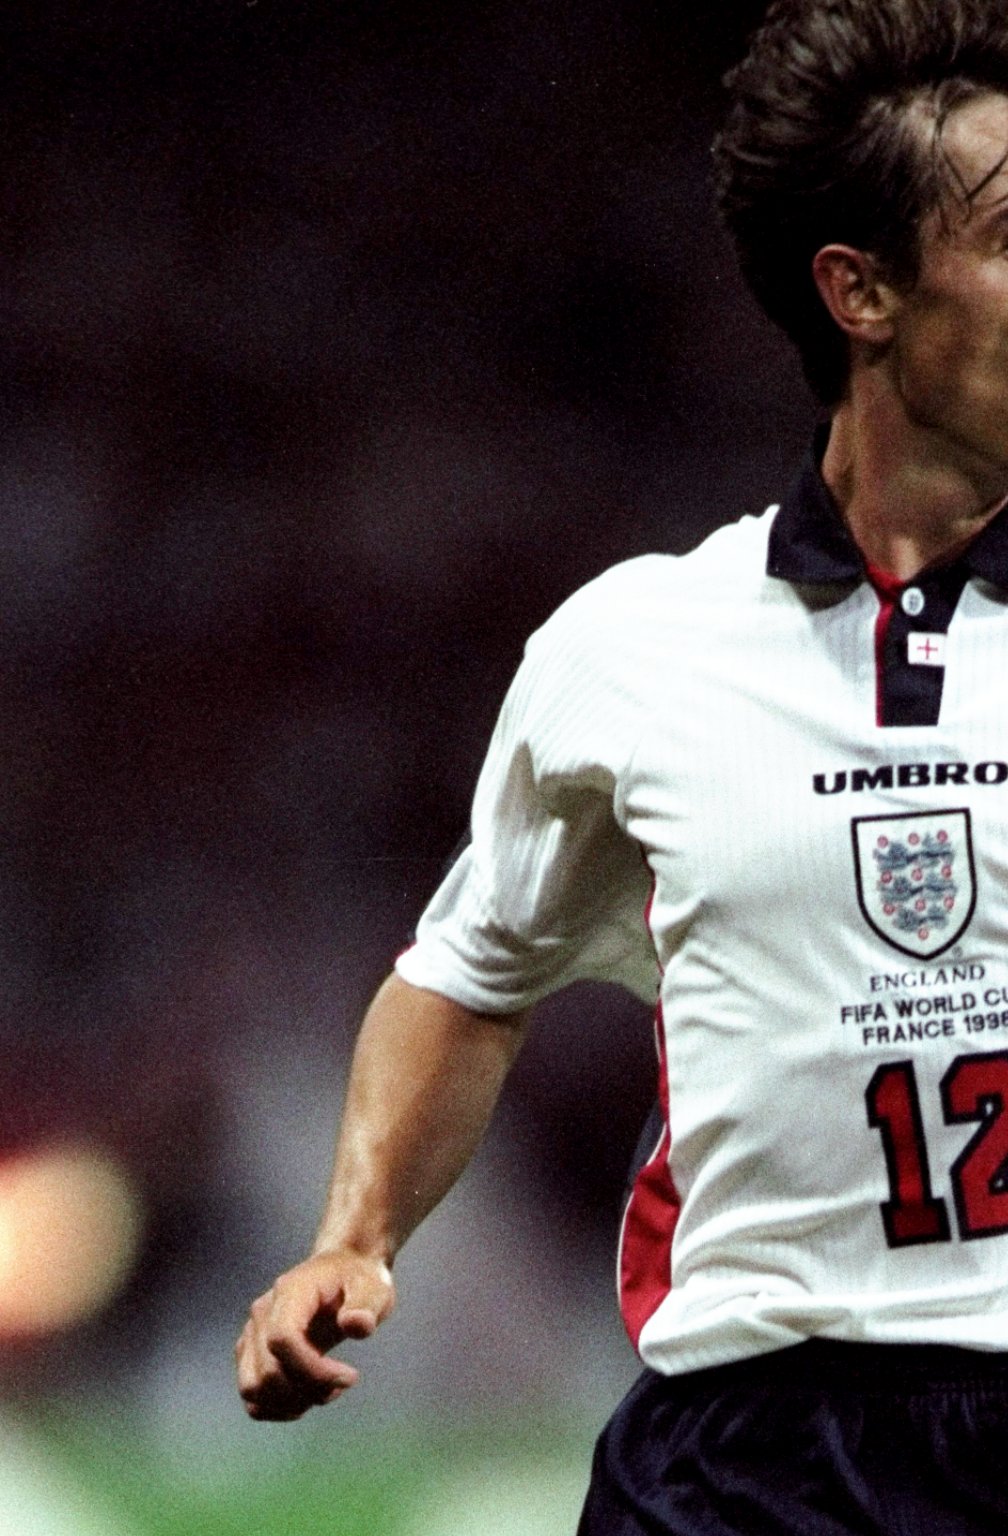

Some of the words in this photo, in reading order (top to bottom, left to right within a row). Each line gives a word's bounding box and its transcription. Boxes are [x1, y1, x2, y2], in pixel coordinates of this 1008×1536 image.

[813, 761, 1008, 794] UMBRO
[869, 963, 986, 992] ENGLAND
[840, 1002, 888, 1024] FIFA
[895, 992, 977, 1019] WORLD
[862, 1018, 955, 1046] FRANCE
